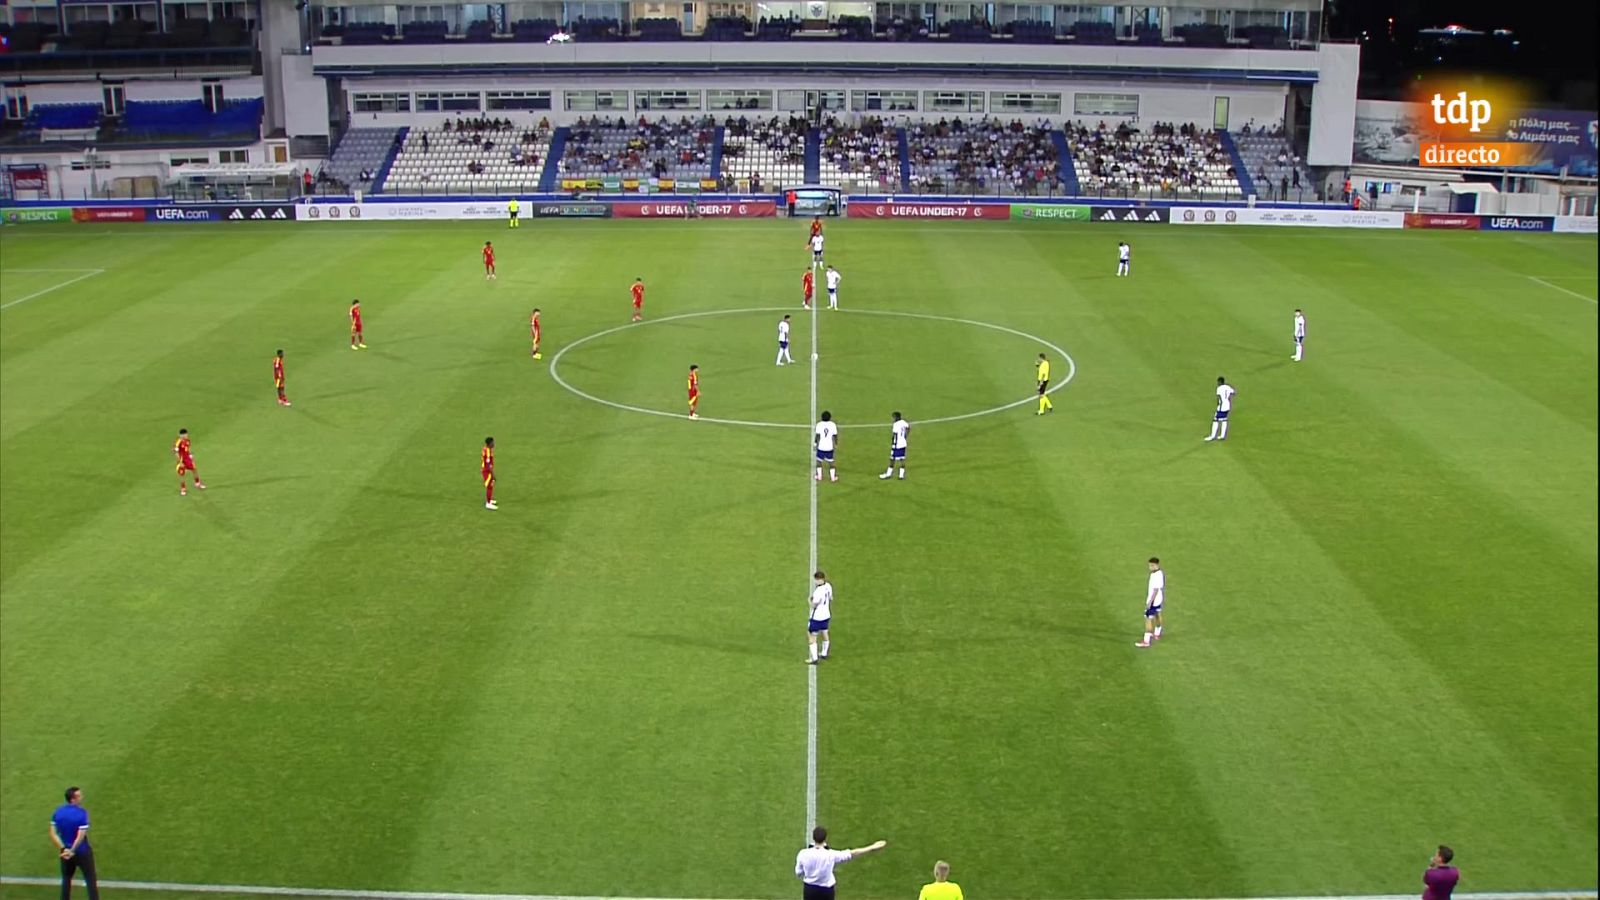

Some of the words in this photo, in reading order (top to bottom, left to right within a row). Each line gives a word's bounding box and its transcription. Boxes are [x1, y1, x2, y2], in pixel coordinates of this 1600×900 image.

[1518, 117, 1547, 129] Πόλη
[1519, 131, 1557, 142] Λιμάνι
[1557, 134, 1580, 145] μας
[156, 208, 209, 219] UEFA.com
[656, 205, 684, 214] UEFA
[891, 206, 919, 216] UEFA
[919, 206, 967, 216] UNDER-17
[1035, 208, 1077, 219] RESPECT
[20, 211, 58, 220] RESPECT
[1491, 218, 1543, 230] UEFA.com
[823, 427, 829, 438] 9
